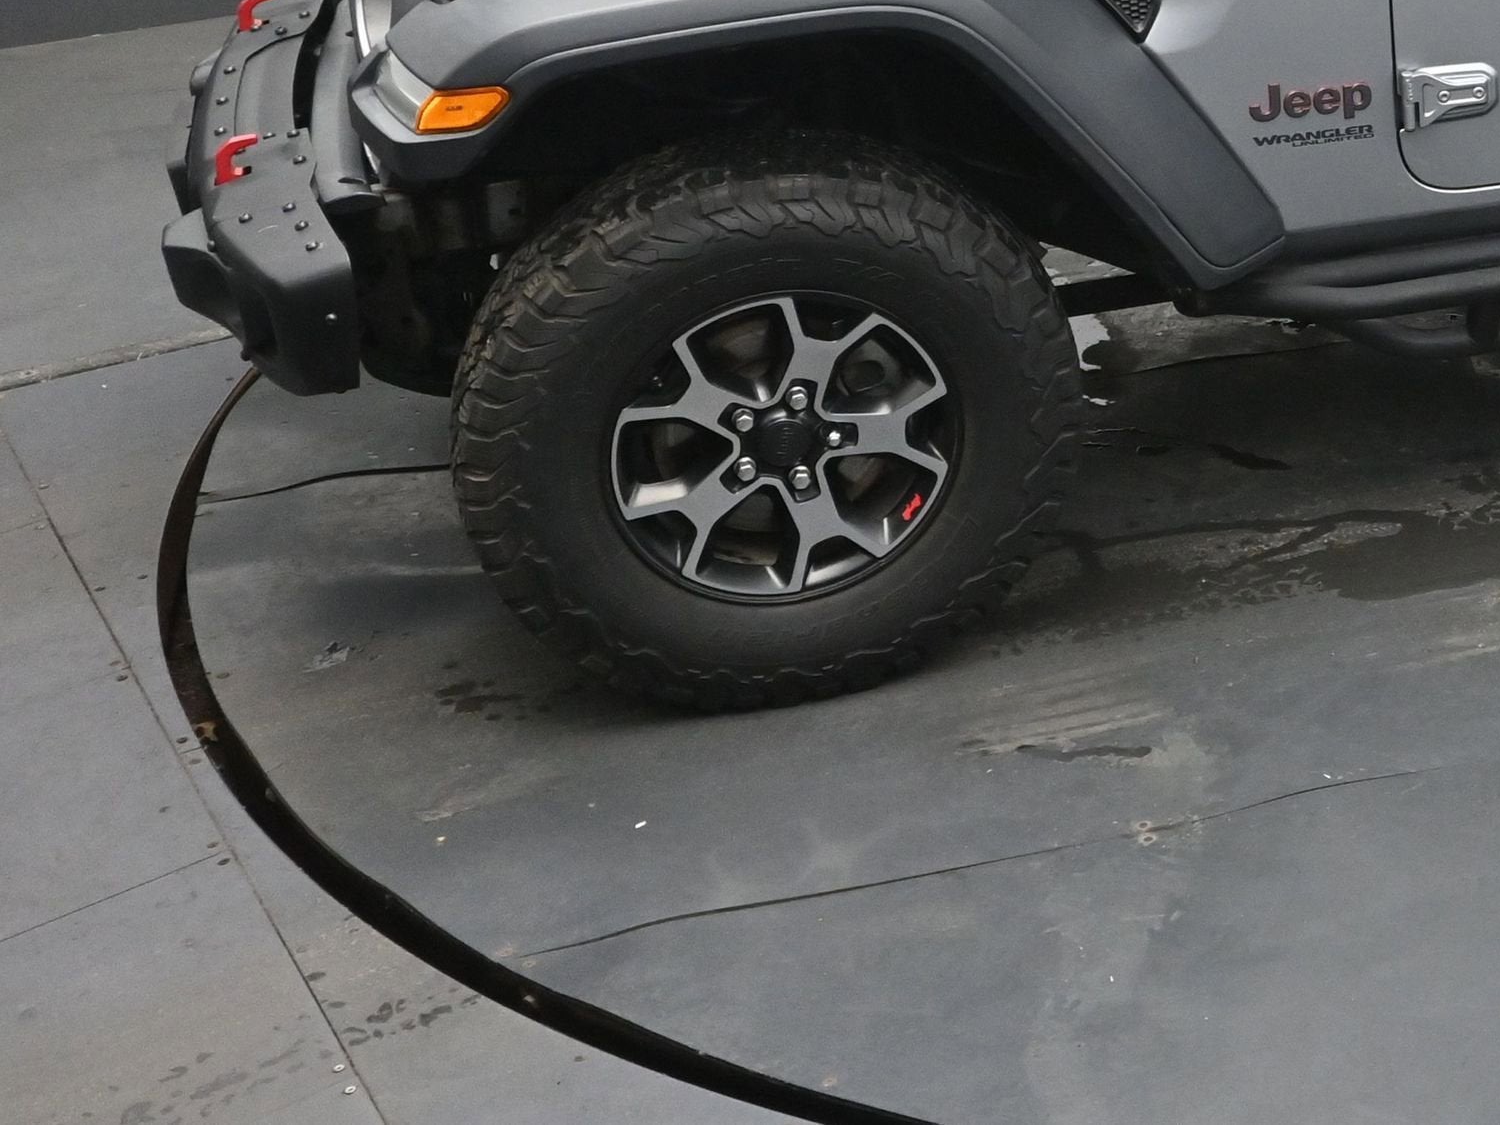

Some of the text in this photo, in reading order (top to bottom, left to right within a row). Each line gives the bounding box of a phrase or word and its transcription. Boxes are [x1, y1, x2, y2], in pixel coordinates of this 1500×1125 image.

[1249, 81, 1372, 122] Jeep
[1252, 124, 1374, 146] WRANGLER
[1291, 133, 1375, 147] UNLIMITED
